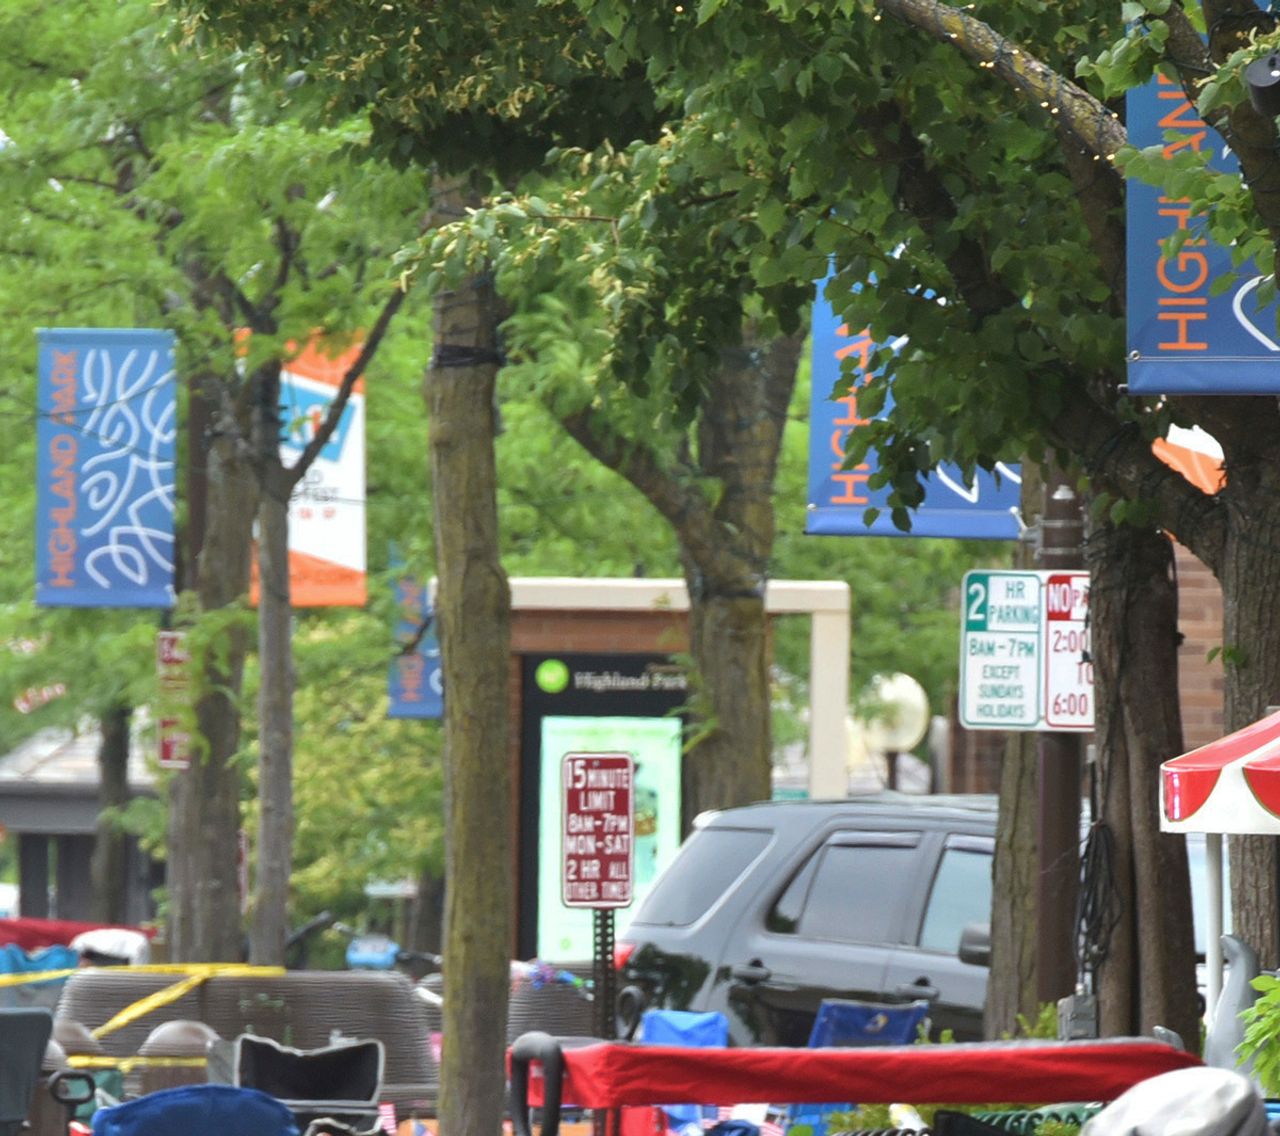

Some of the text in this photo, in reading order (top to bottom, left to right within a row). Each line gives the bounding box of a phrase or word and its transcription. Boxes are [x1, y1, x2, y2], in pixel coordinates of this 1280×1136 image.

[48, 433, 77, 588] HIGHLAND
[967, 581, 1025, 621] 2 HR
[1048, 583, 1071, 613] NO
[989, 604, 1040, 624] PARKING
[574, 670, 651, 692] Highland
[982, 664, 1020, 680] EXCEPT
[978, 684, 1025, 699] SUNDAYS
[976, 703, 1026, 719] HOLIDAYS
[1053, 693, 1088, 716] 6:00
[567, 760, 629, 790] 15 MINUTE
[579, 790, 616, 811] LIMIT
[567, 859, 628, 880] 2 HR ALL
